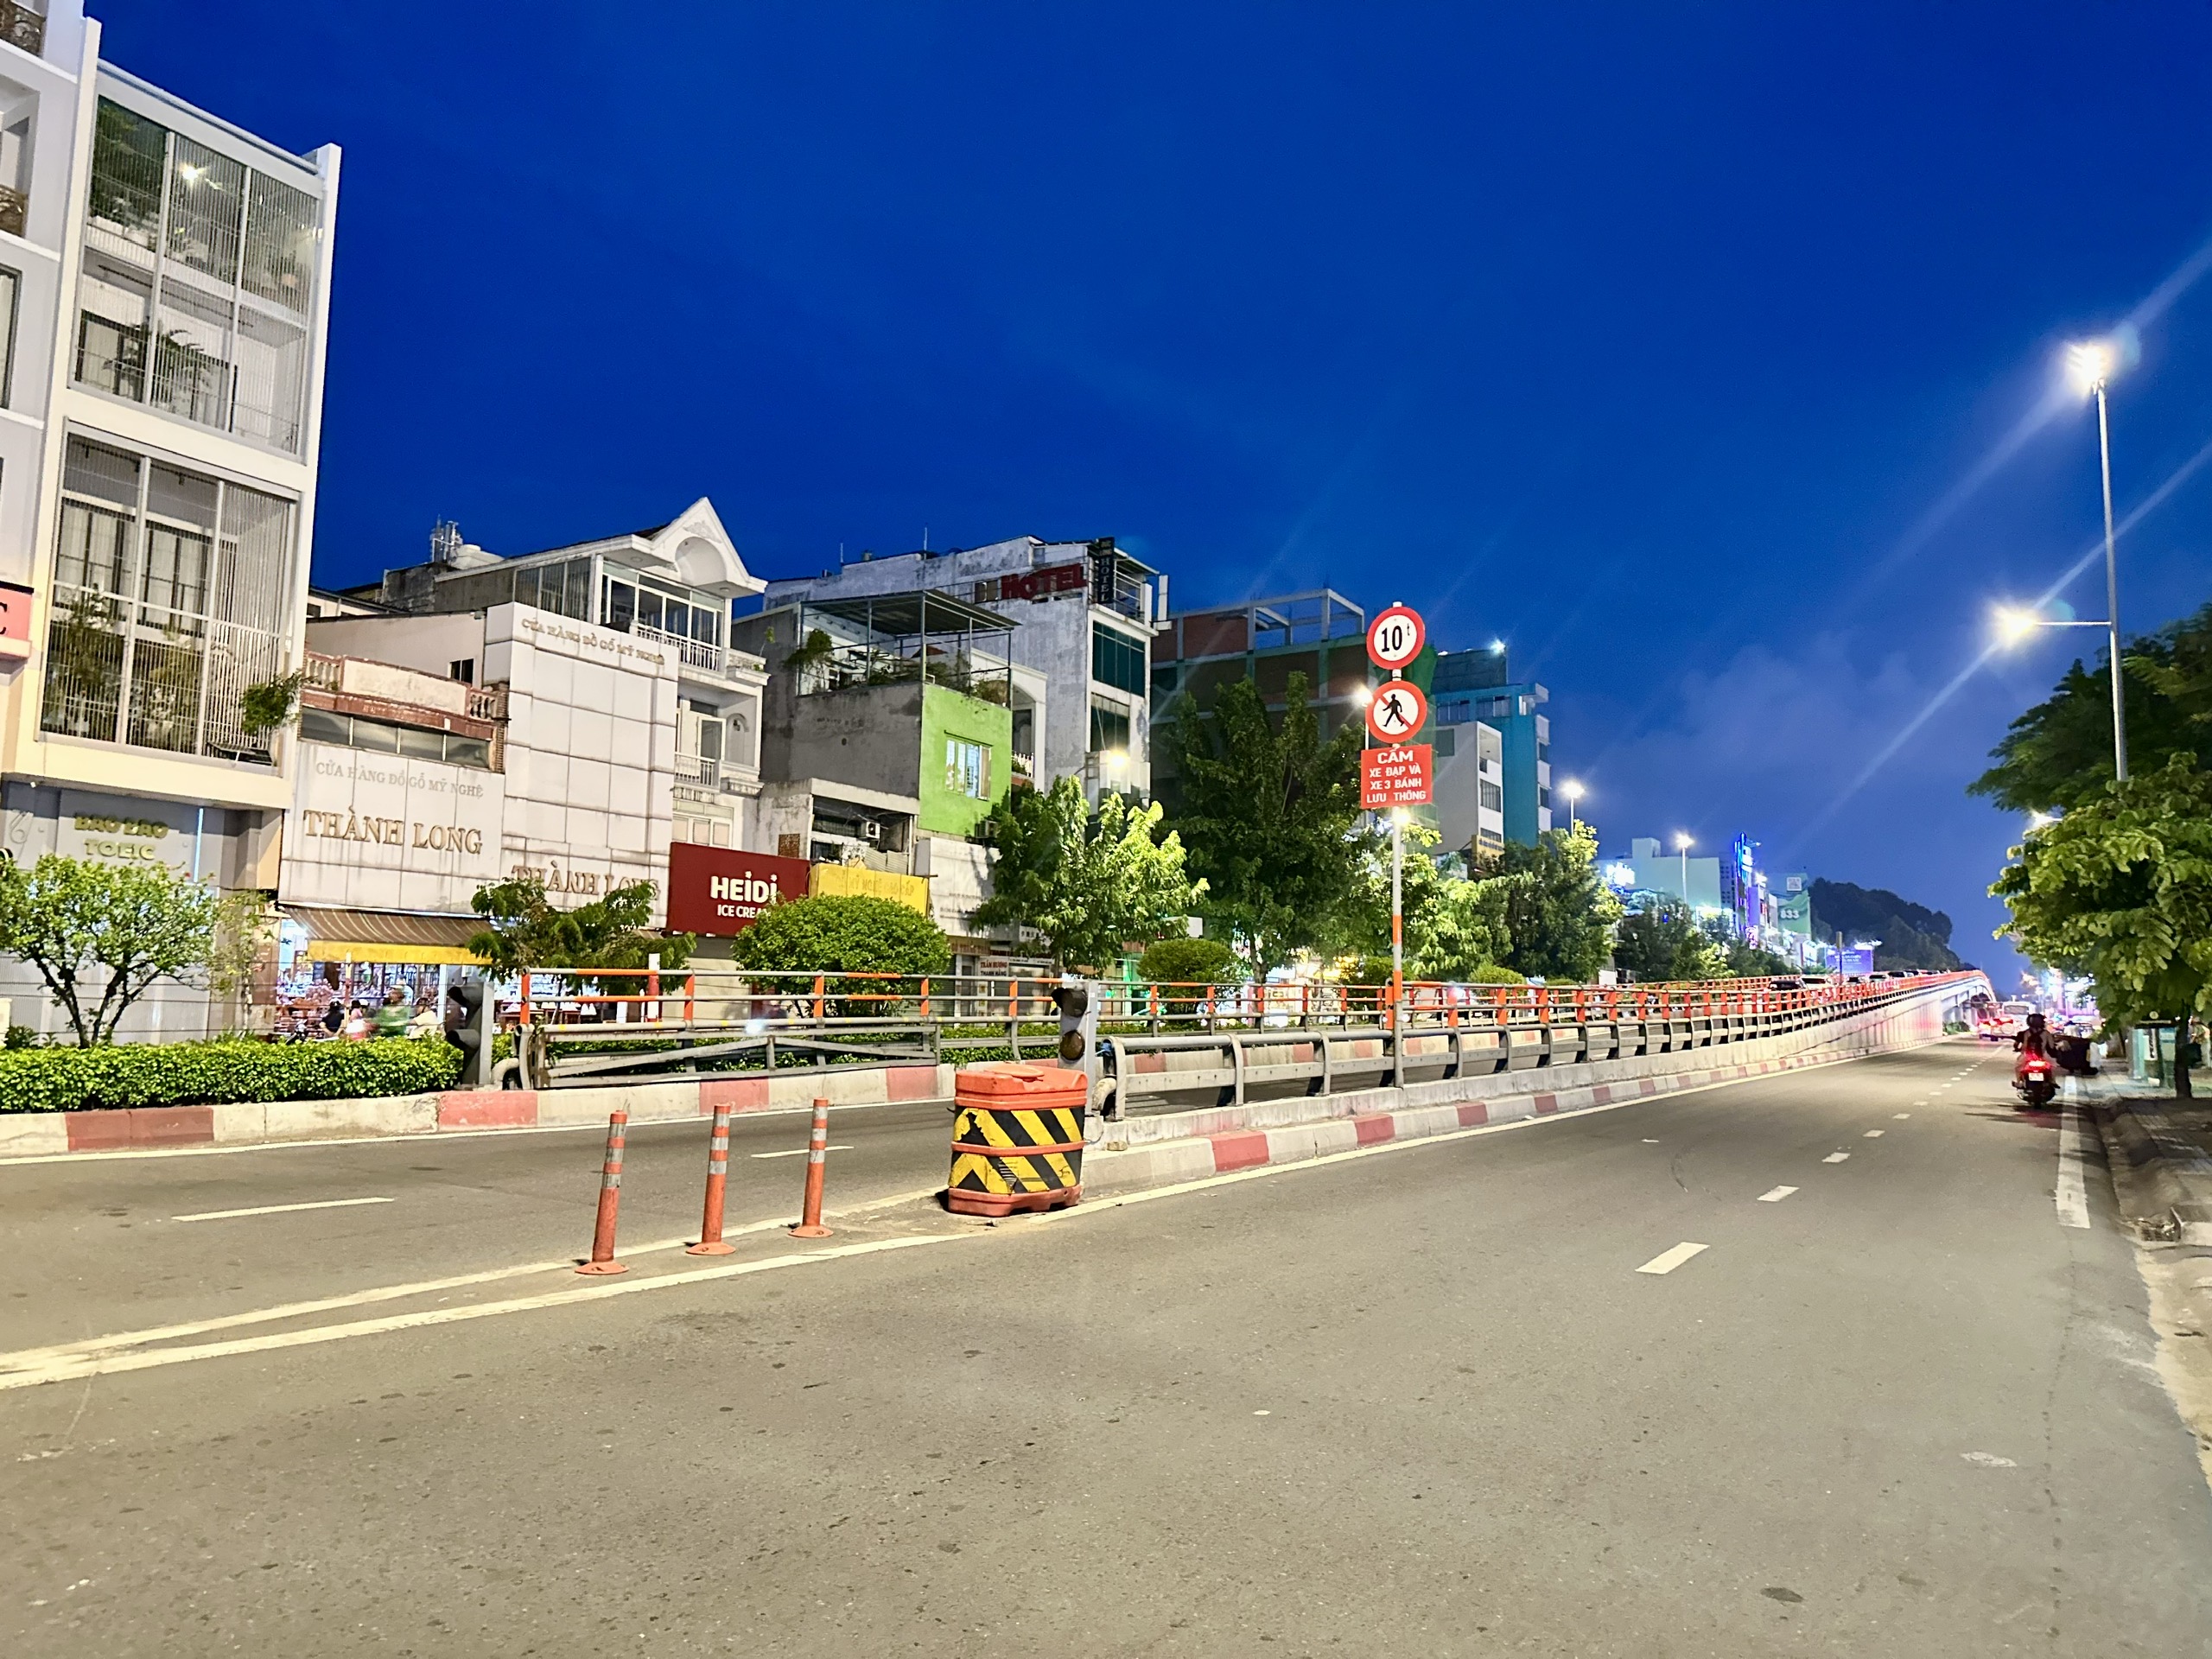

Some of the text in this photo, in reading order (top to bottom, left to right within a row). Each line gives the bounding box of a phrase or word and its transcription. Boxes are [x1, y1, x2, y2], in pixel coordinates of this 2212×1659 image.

[1001, 563, 1087, 601] HOTEL
[1100, 557, 1110, 602] HOTEL
[315, 759, 484, 799] CỬA HÀNG ĐỒ GỖ MỸ NGHỆ
[1369, 762, 1422, 778] XE ĐẠP VÀ
[1370, 777, 1422, 791] XE 3 BÁNH
[1366, 790, 1427, 804] LƯU THÔNG
[303, 805, 484, 855] THÀNH LONG
[84, 838, 156, 861] TOEIC
[512, 860, 601, 896] THÀNH
[717, 904, 735, 917] ICE
